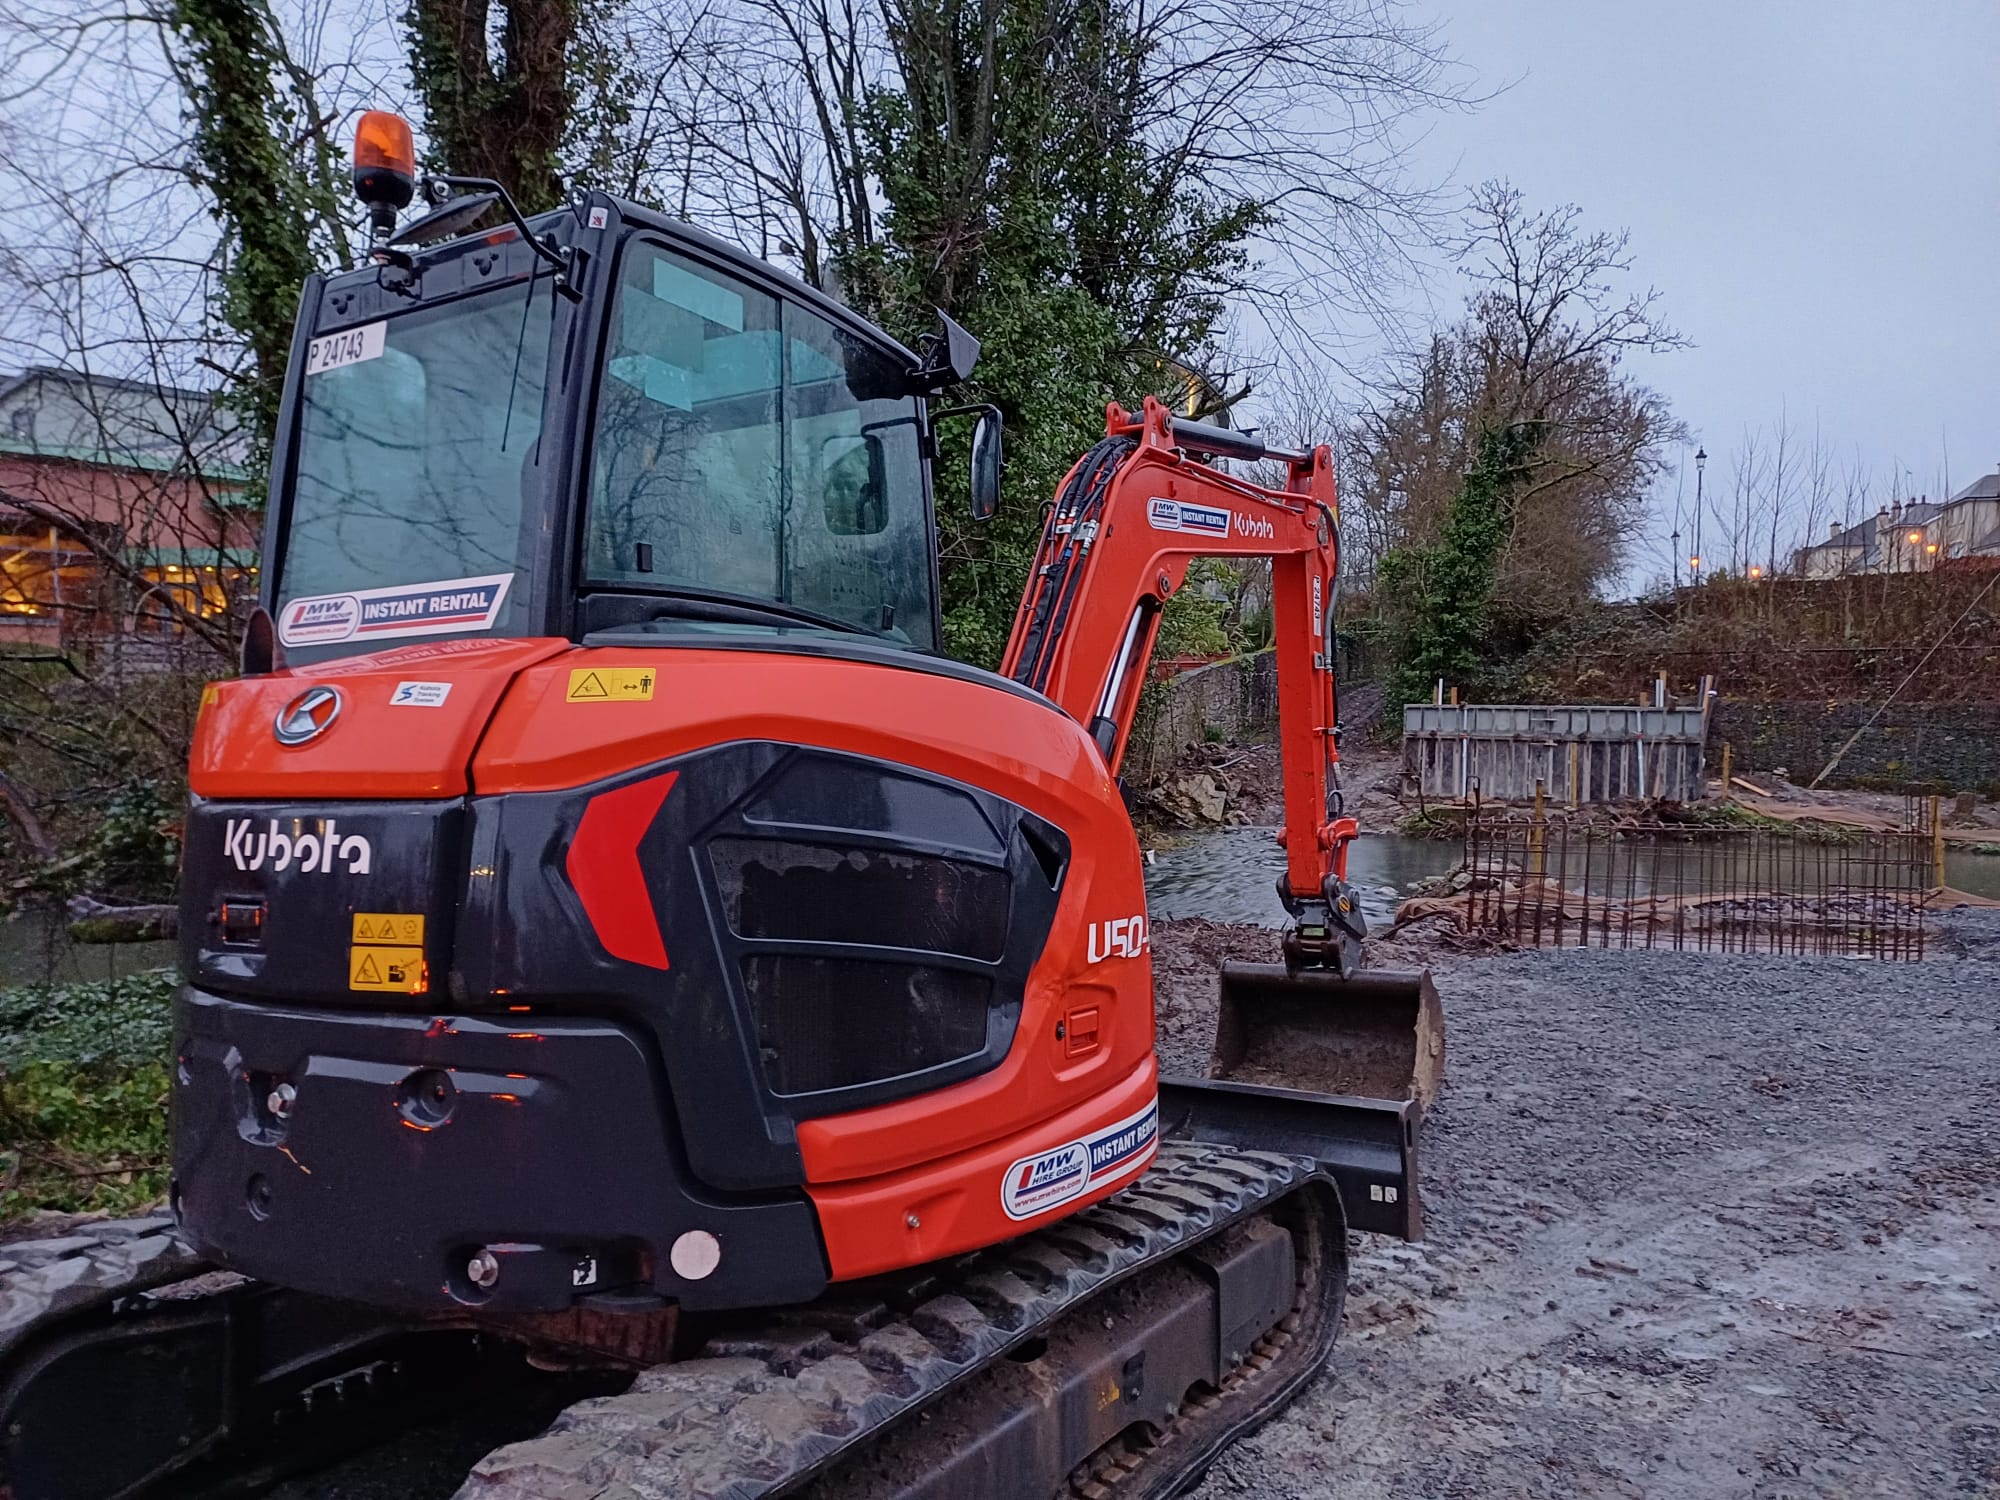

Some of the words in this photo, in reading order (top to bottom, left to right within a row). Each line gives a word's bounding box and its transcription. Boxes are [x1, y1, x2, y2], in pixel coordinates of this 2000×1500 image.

[308, 343, 319, 371] P
[322, 331, 364, 367] 24743
[1158, 503, 1175, 511] MW
[1182, 511, 1205, 523] INSTANT
[1206, 515, 1226, 526] RENTAL
[1233, 512, 1275, 540] Kubota
[306, 600, 346, 616] MW
[364, 598, 426, 619] INSTANT
[429, 592, 488, 613] RENTAL
[223, 818, 371, 875] Kubota
[1035, 1149, 1076, 1176] MW
[1093, 1133, 1137, 1165] INSTANT
[1031, 1172, 1055, 1186] HIRE
[1056, 1159, 1084, 1178] GROUP
